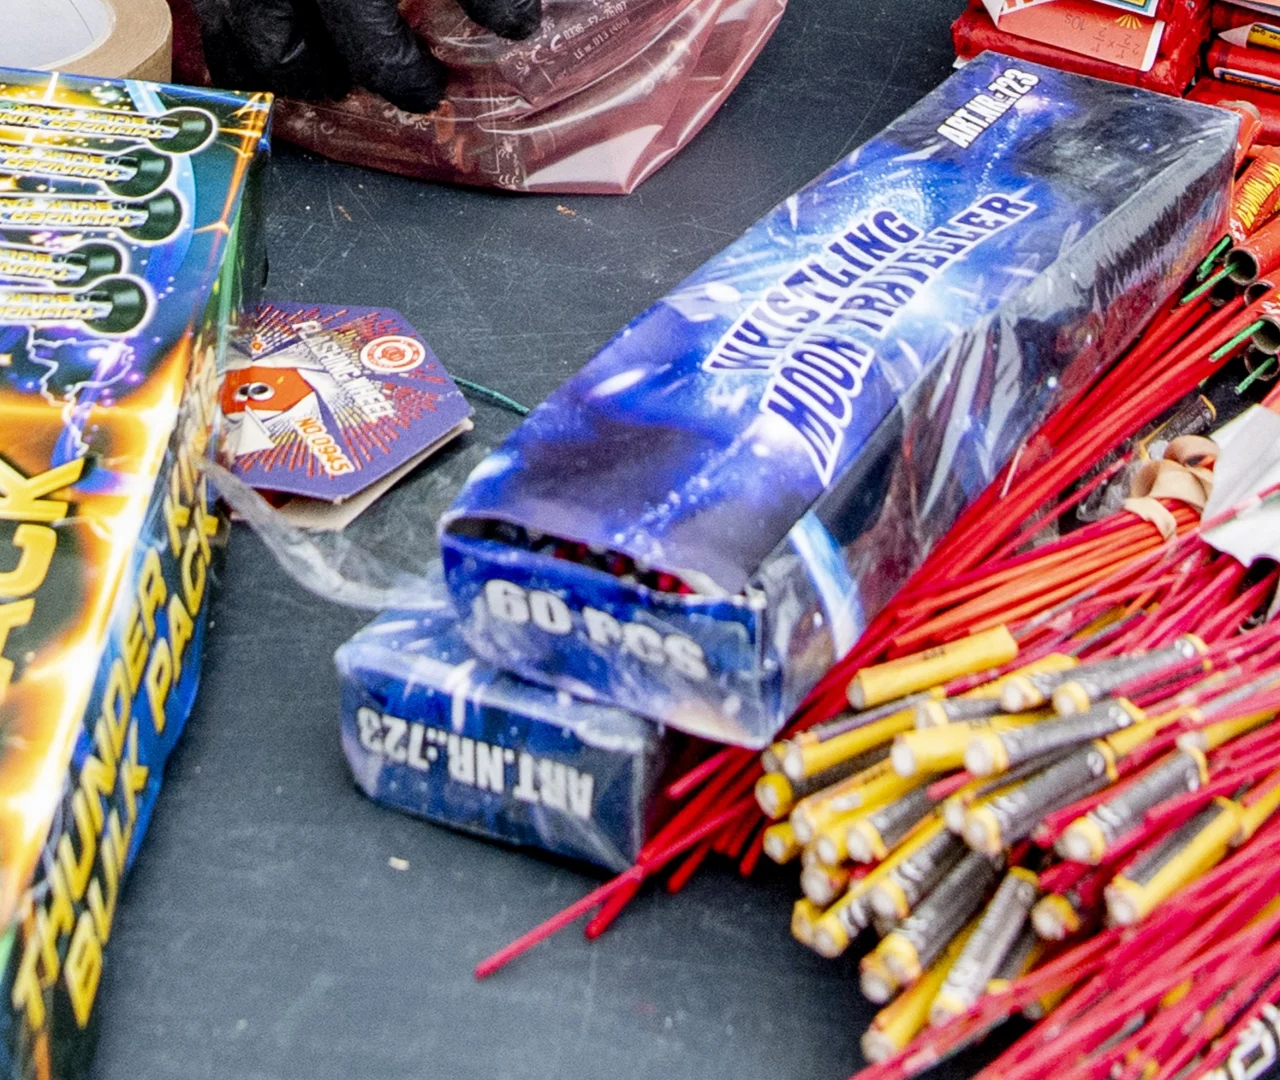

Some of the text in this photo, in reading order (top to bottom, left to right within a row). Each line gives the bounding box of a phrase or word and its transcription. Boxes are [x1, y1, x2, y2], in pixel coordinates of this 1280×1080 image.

[760, 310, 880, 487] MOON
[833, 186, 1039, 377] TRAVELLER
[484, 578, 571, 635] 60
